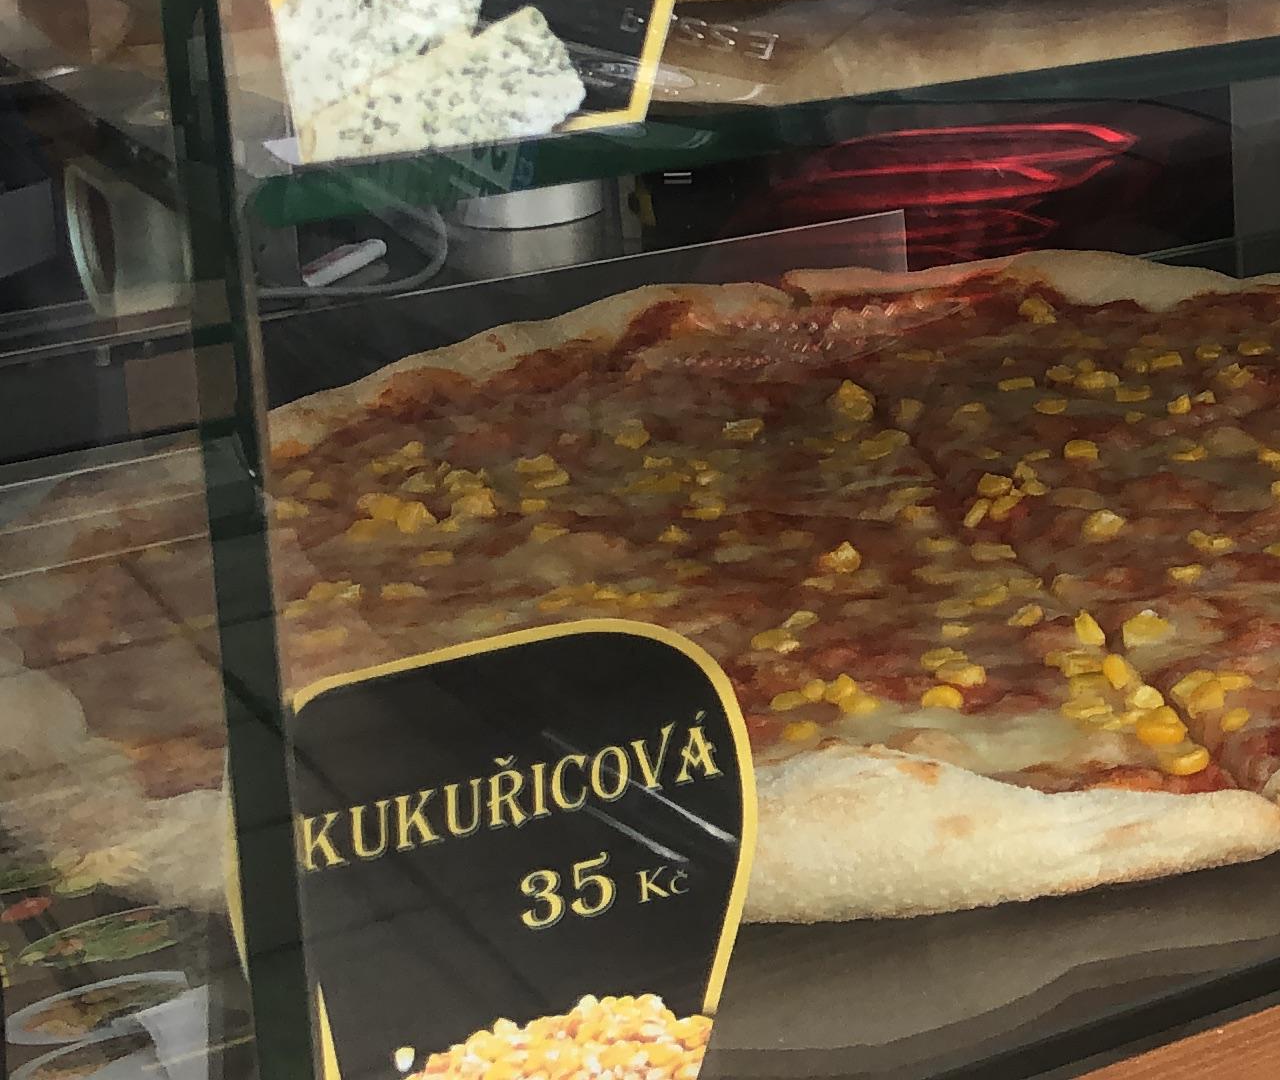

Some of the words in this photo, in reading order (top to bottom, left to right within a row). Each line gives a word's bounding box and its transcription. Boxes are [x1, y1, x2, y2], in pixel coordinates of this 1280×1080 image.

[301, 710, 723, 872] KUKUŘICOVÁ
[520, 852, 616, 931] 35
[636, 866, 690, 904] Kč
